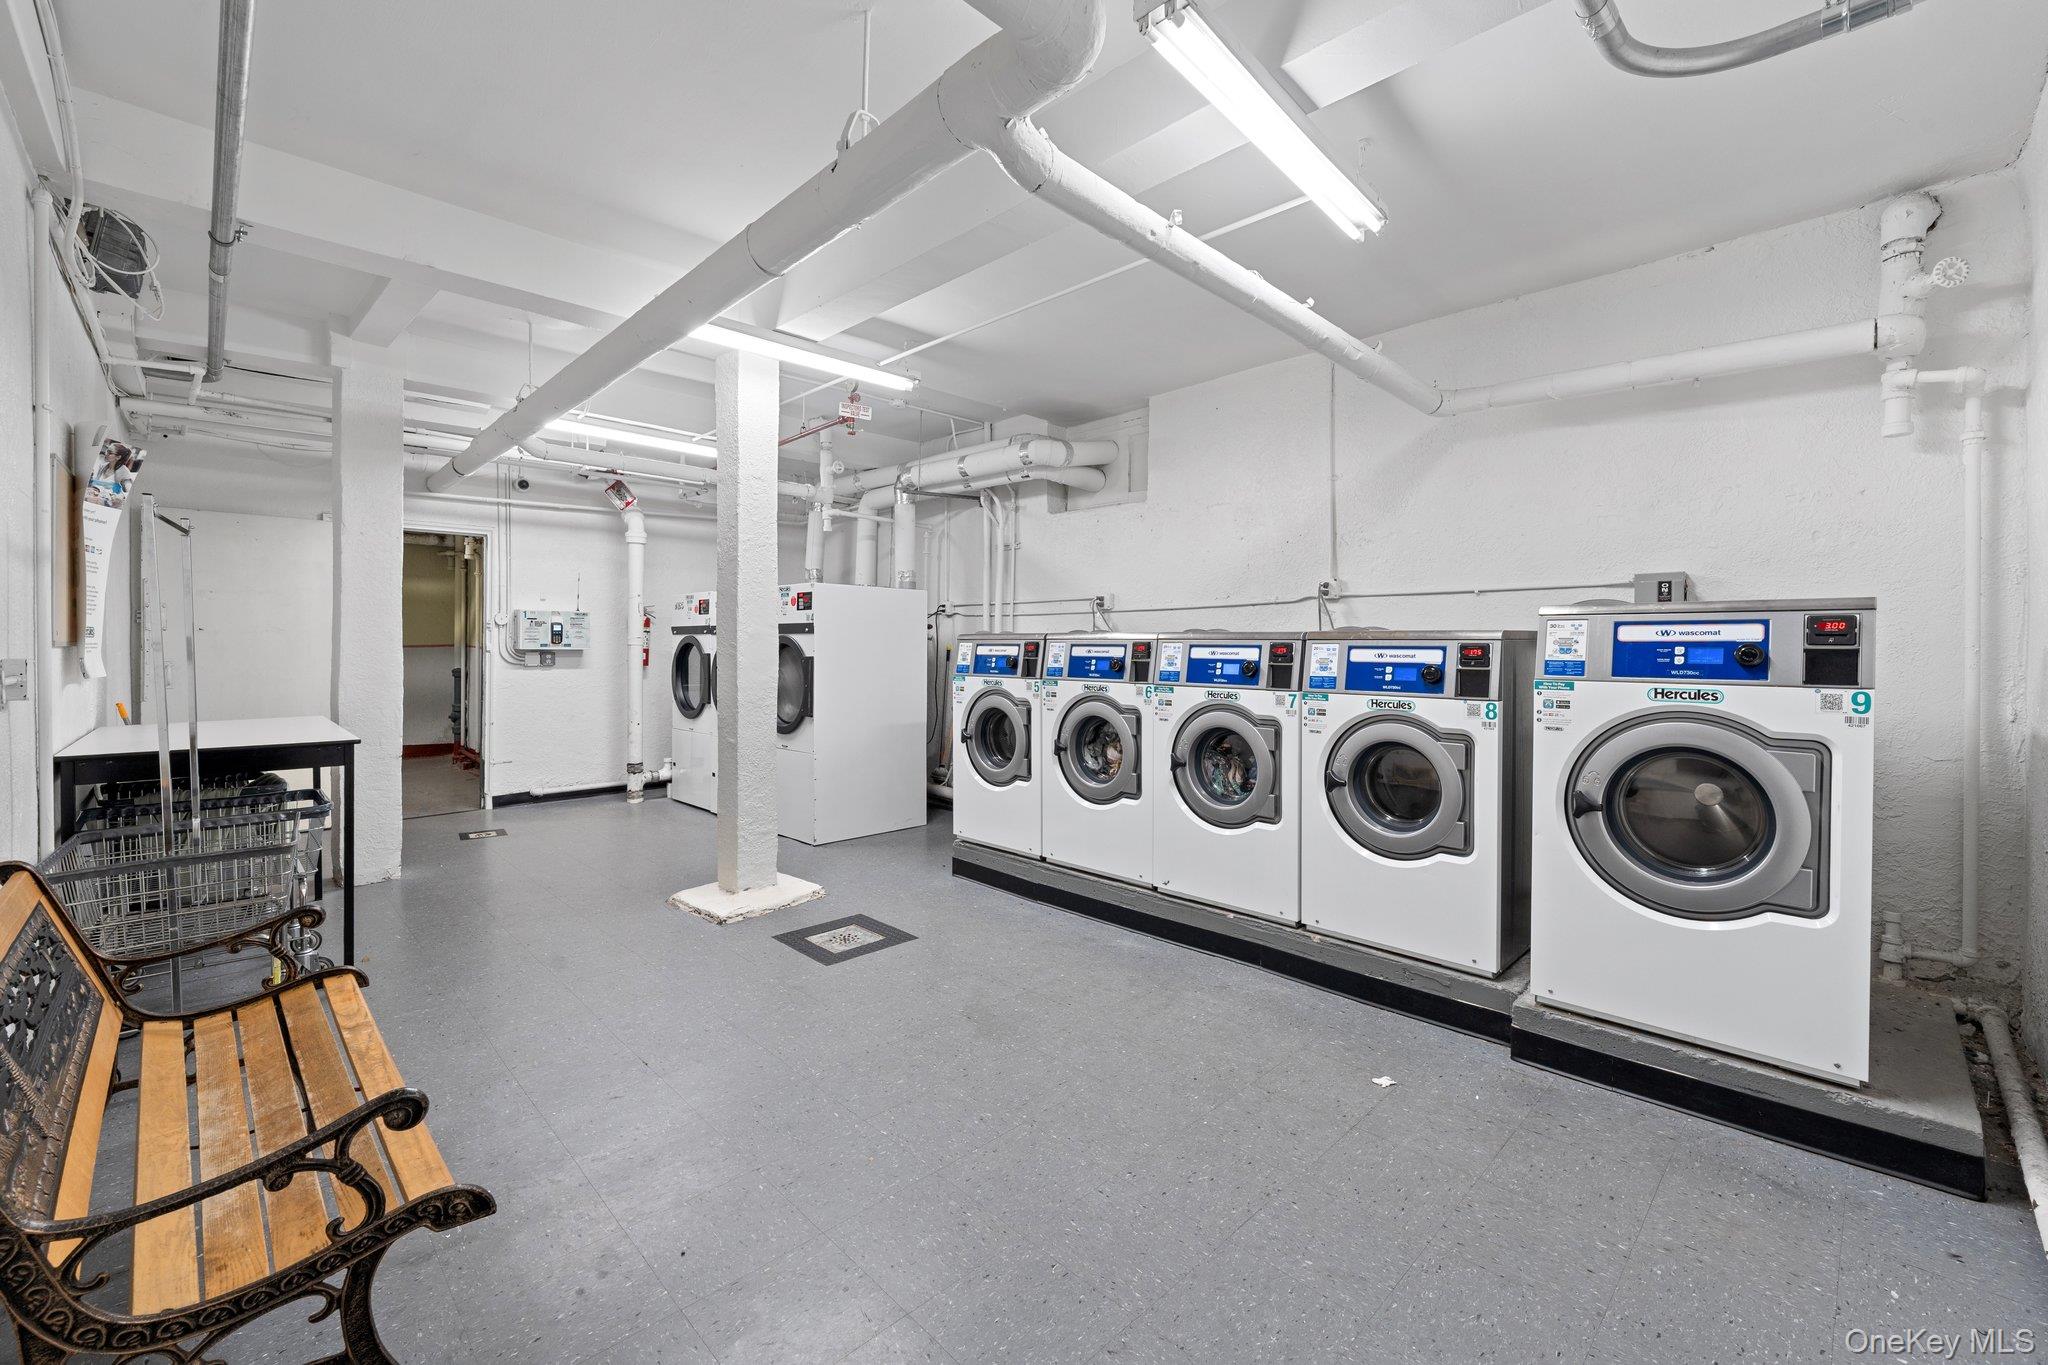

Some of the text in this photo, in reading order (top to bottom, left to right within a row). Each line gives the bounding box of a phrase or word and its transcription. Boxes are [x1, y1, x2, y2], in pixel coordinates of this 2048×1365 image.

[1678, 629, 1721, 637] wascomat
[1033, 681, 1040, 693] 5
[1083, 684, 1108, 693] Hercules
[1145, 685, 1153, 699] 6
[1207, 691, 1238, 700] Hercules
[1287, 693, 1298, 709] 7
[1653, 687, 1719, 703] Hercules
[1370, 699, 1412, 710] Hercules
[1851, 691, 1872, 715] 9
[1485, 702, 1498, 720] 8
